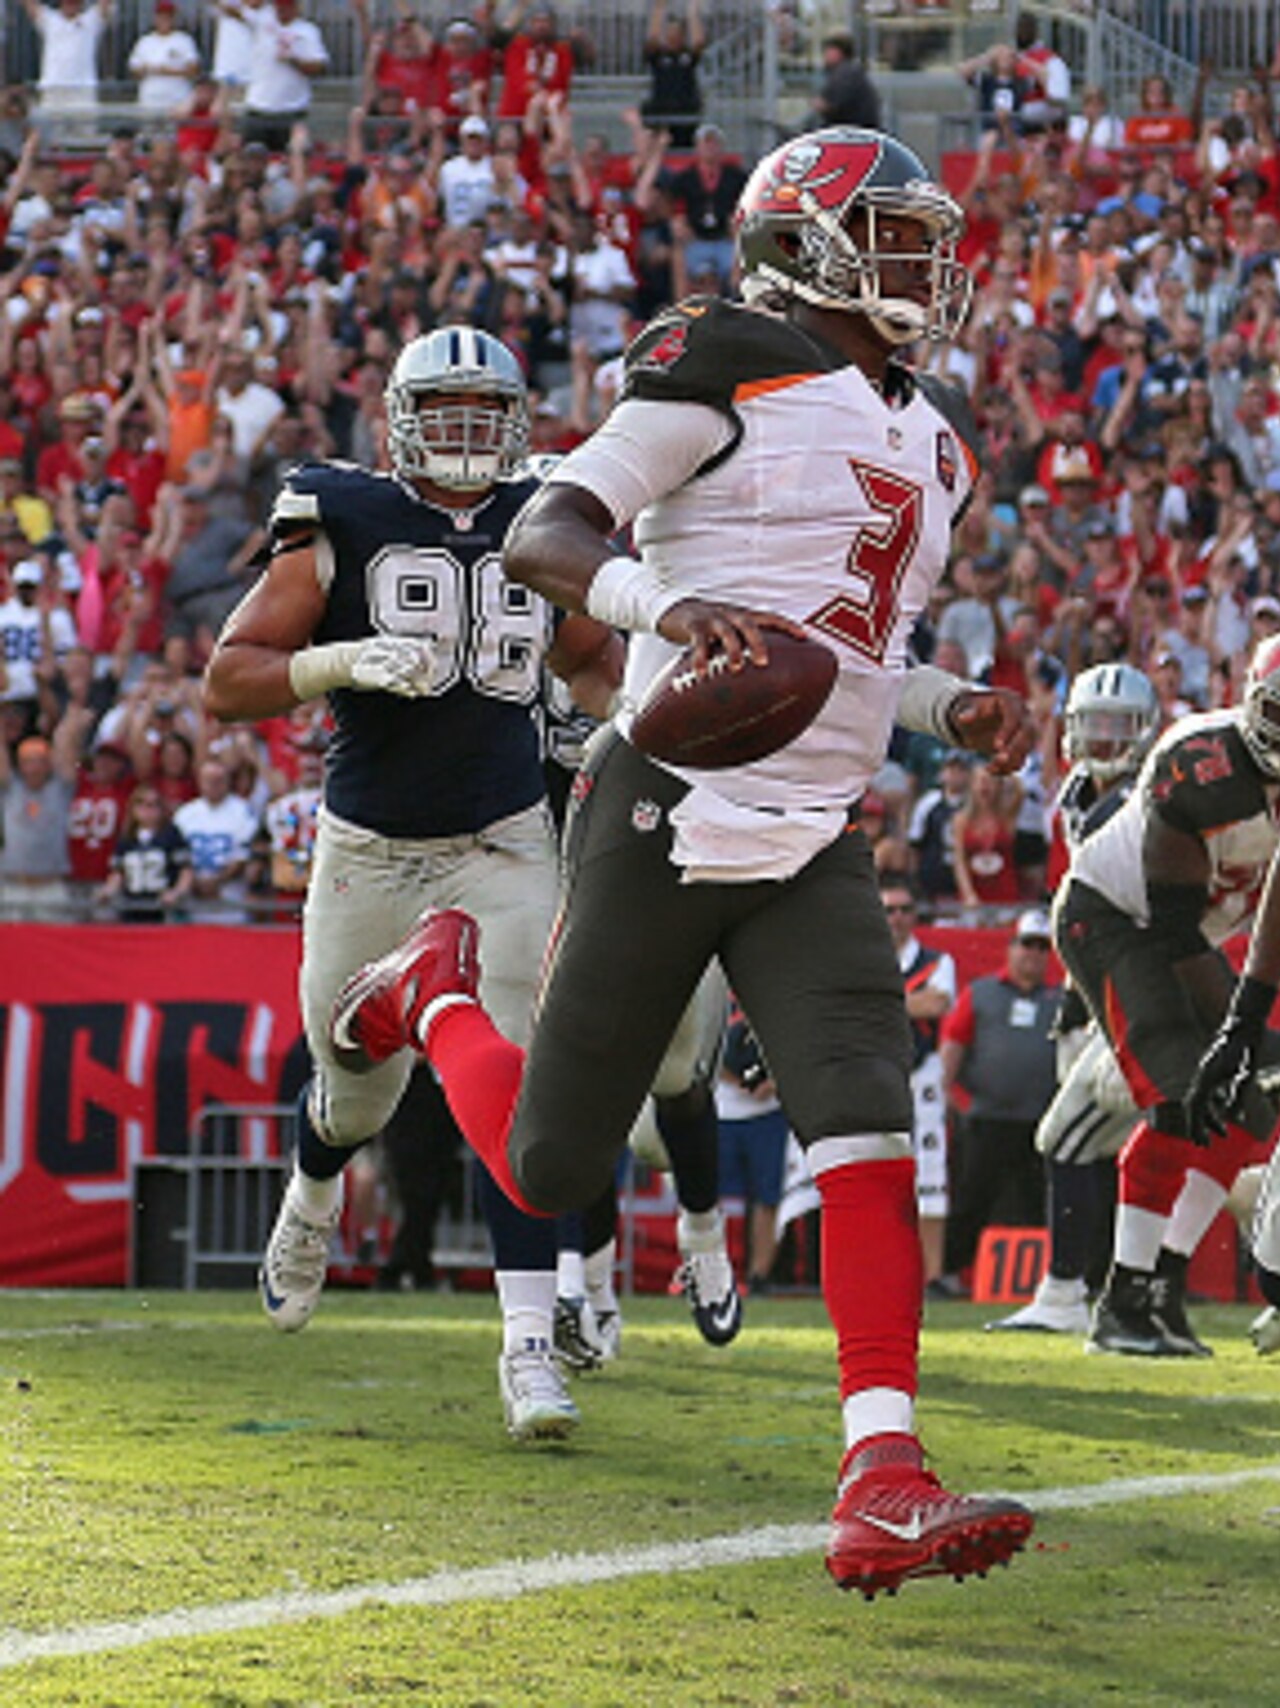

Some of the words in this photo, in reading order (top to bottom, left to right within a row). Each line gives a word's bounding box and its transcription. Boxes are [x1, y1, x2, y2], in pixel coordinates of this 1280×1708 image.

[365, 544, 553, 704] 98
[806, 458, 922, 664] 3
[989, 1239, 1044, 1296] 10
